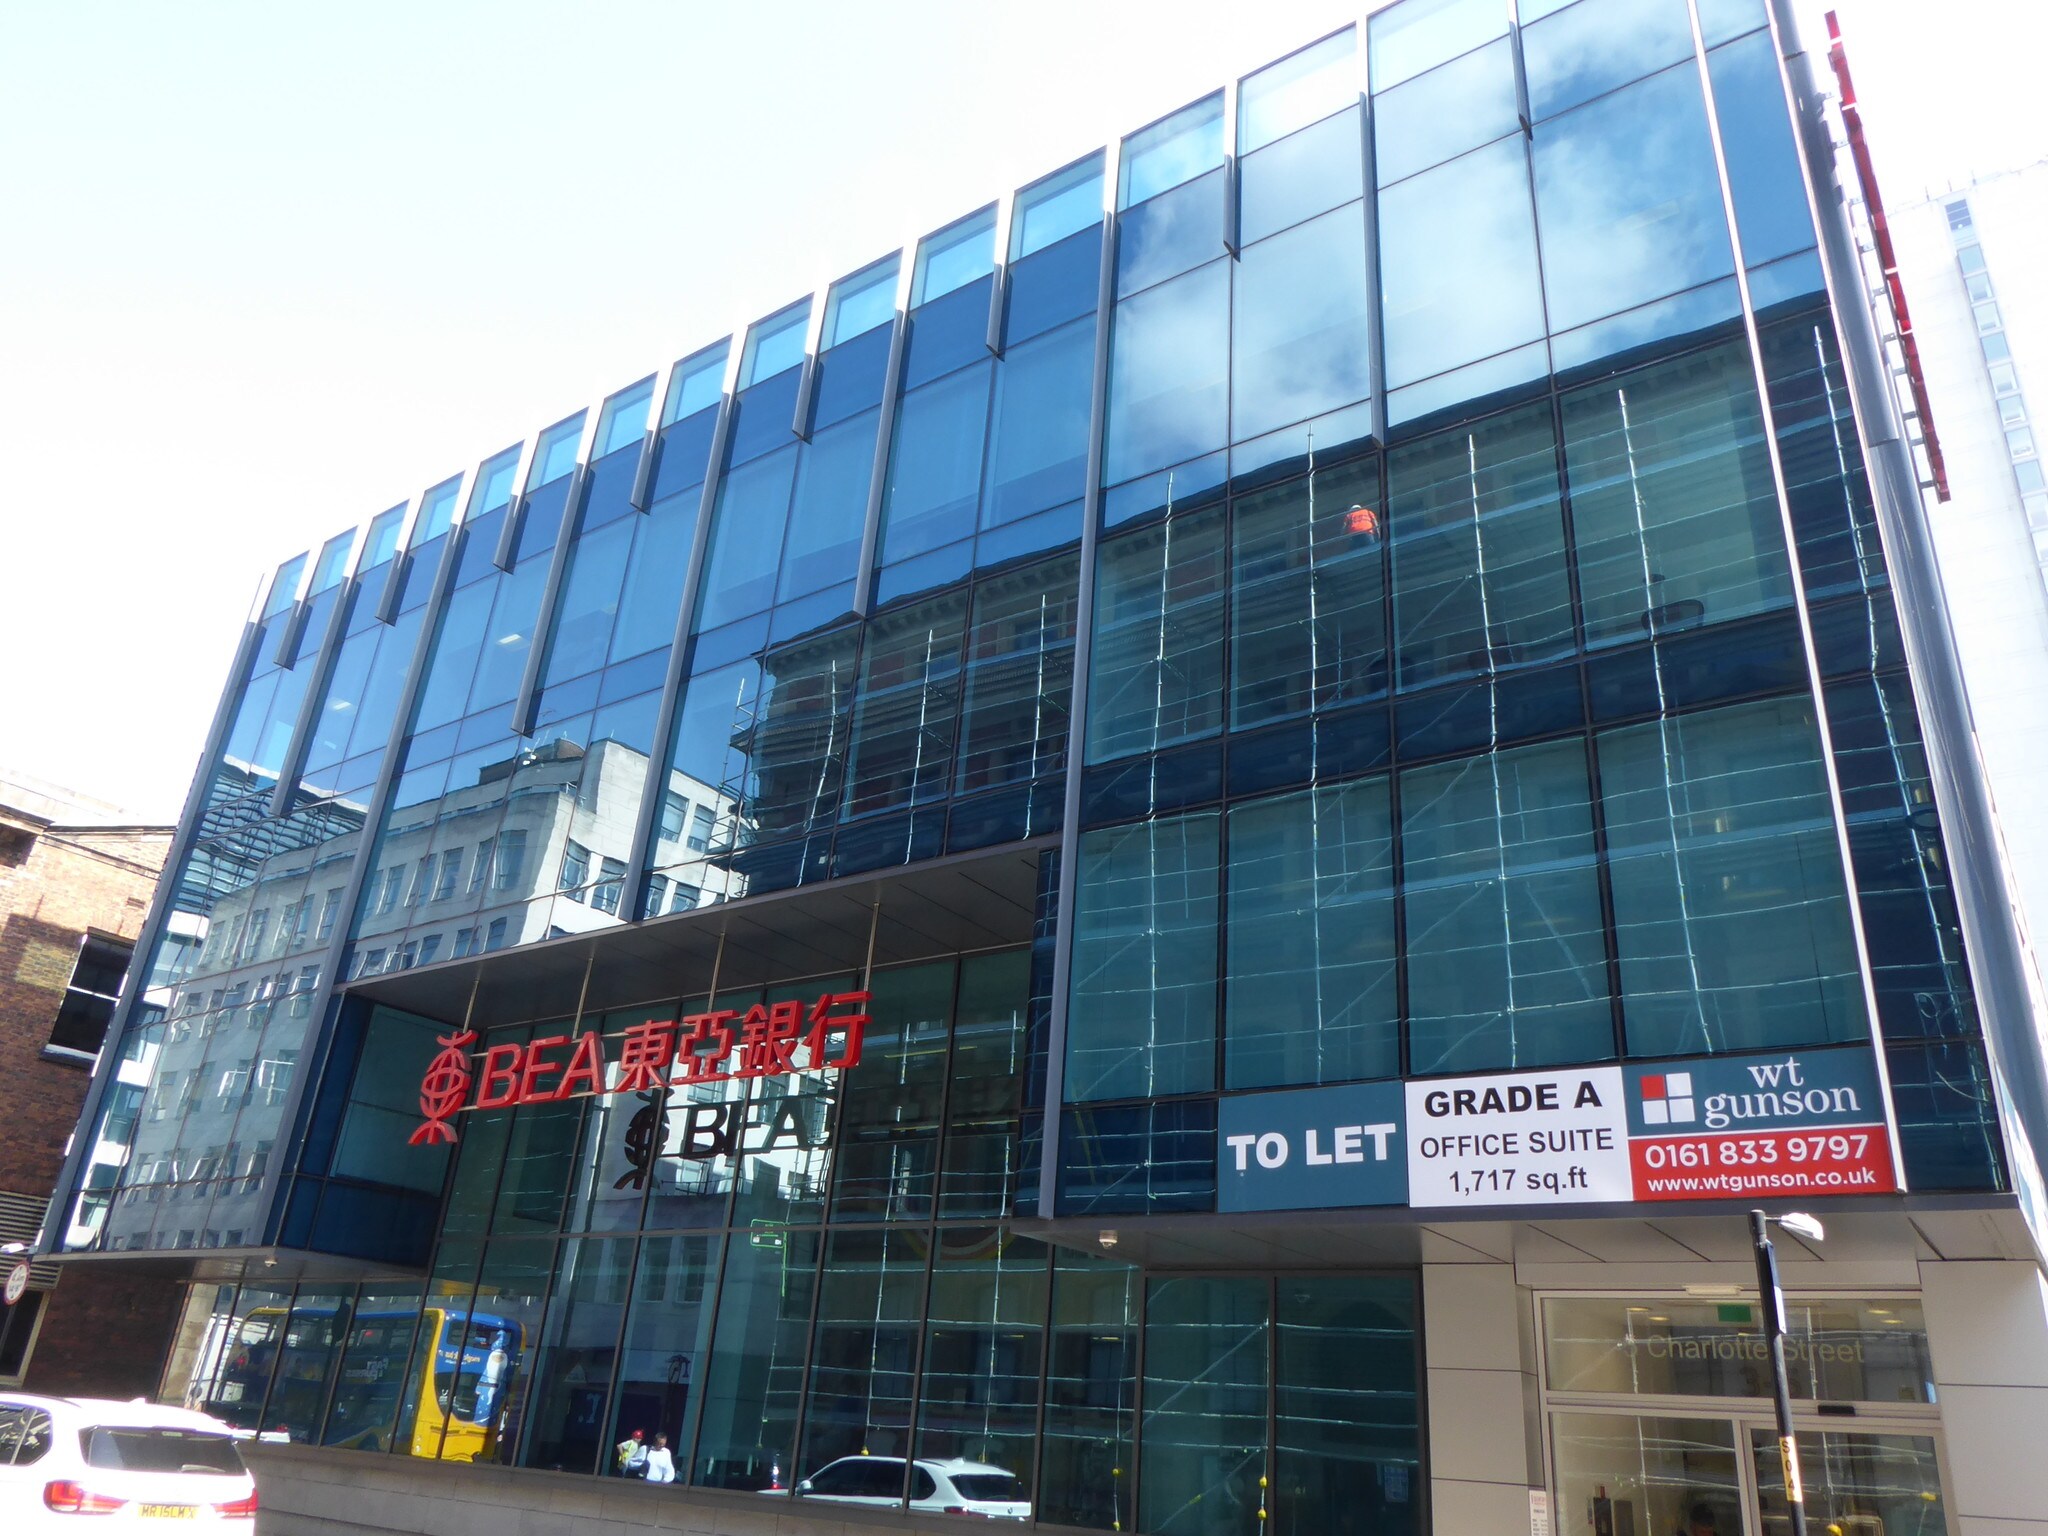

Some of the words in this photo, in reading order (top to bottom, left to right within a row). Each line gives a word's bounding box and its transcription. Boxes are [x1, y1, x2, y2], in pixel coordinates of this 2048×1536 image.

[476, 1031, 606, 1109] BEA
[614, 990, 873, 1090] 東亞銀行
[1747, 1056, 1805, 1088] wt
[1424, 1083, 1560, 1118] GRADE
[1573, 1080, 1603, 1109] A
[1704, 1087, 1861, 1129] gunson
[1226, 1132, 1289, 1170] TO
[1305, 1123, 1397, 1166] LET
[1420, 1132, 1520, 1158] OFFICE
[1528, 1127, 1615, 1154] SUITE
[1645, 1142, 1711, 1169] 0161
[1718, 1139, 1778, 1166] 833
[1787, 1134, 1869, 1161] 9797
[1449, 1168, 1516, 1196] 1,717
[1526, 1165, 1589, 1195] sq.ft
[1647, 1166, 1876, 1192] www.wtgunson.co.uk
[1647, 1333, 1769, 1361] Charlotte
[1782, 1338, 1864, 1363] Street
